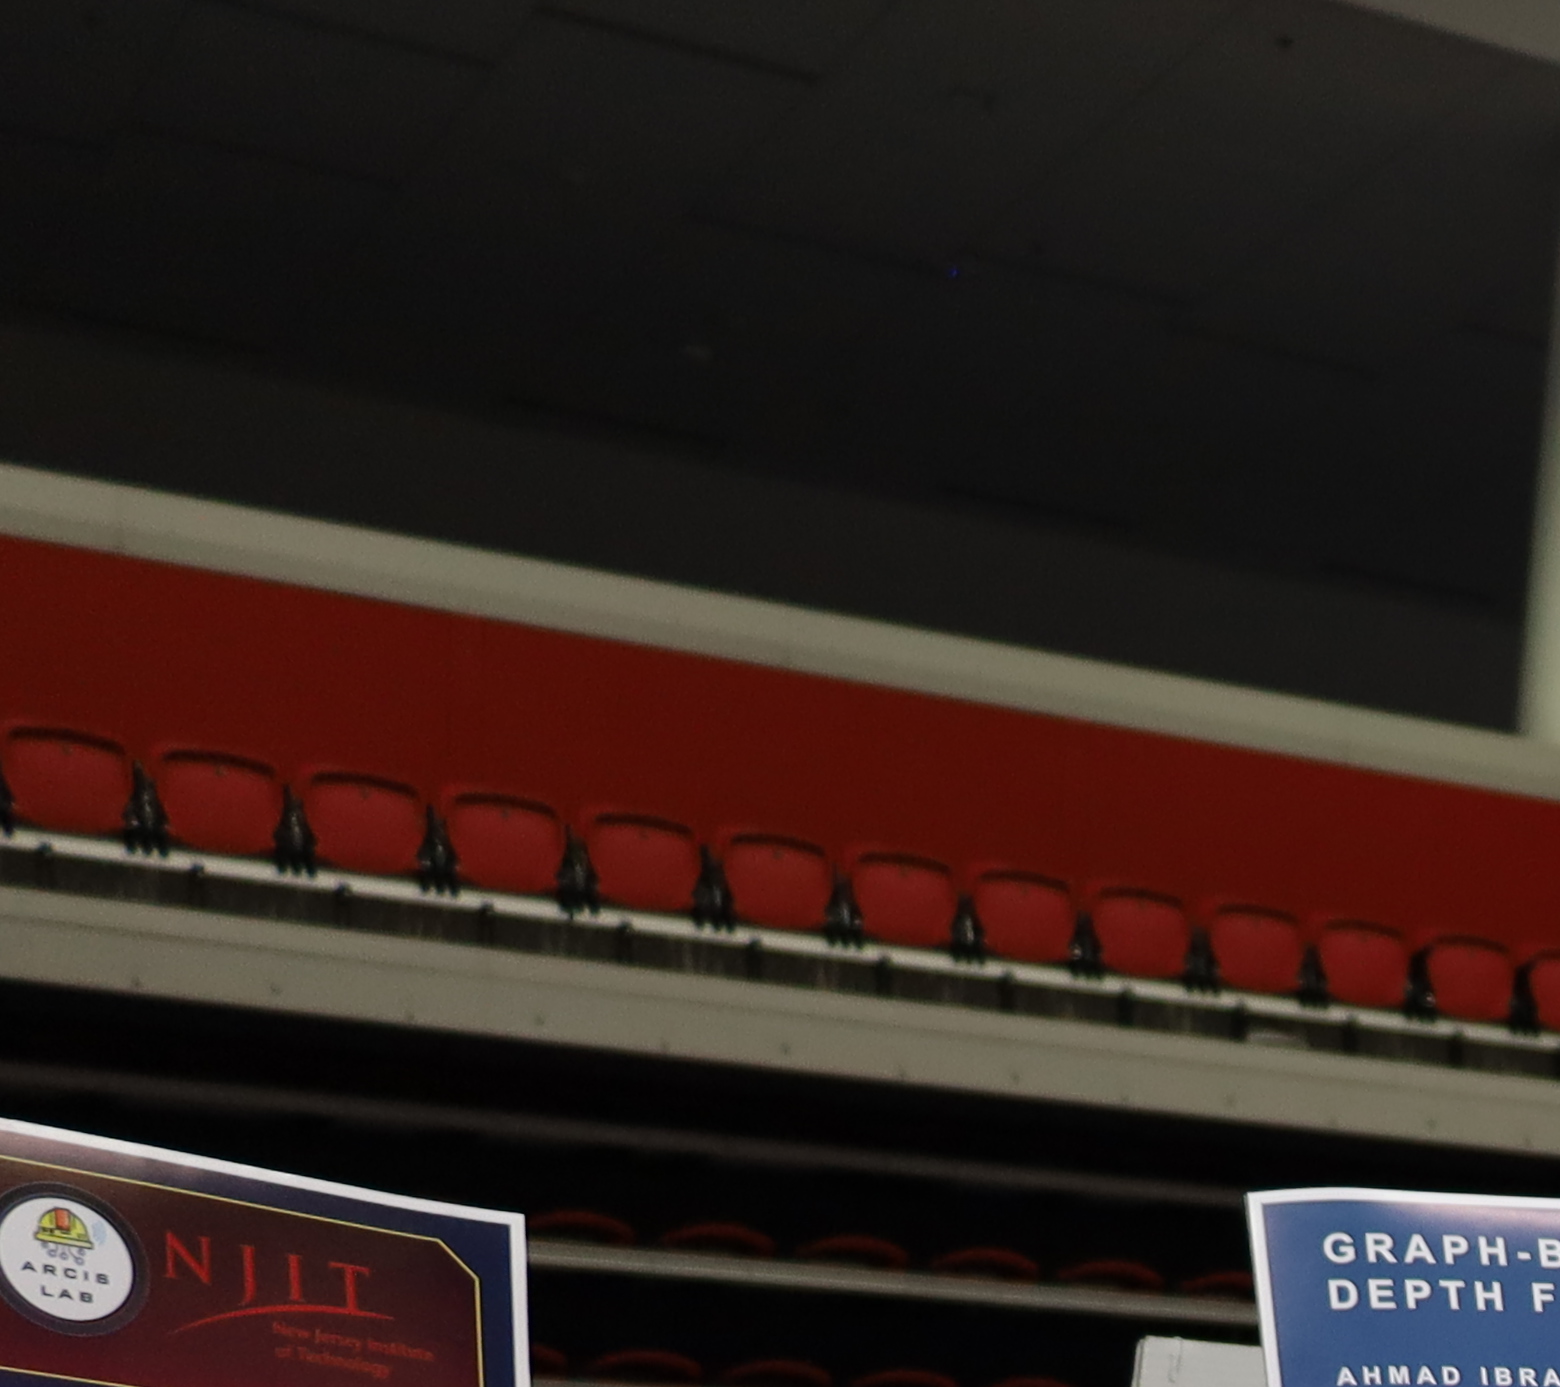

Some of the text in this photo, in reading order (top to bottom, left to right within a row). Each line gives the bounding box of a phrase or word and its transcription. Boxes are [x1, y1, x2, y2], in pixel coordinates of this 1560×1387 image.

[21, 1261, 109, 1285] ARCIS
[163, 1232, 371, 1315] NJIT
[41, 1286, 93, 1303] LAB
[1328, 1279, 1503, 1311] DEPTH
[272, 1321, 310, 1341] New
[314, 1329, 363, 1353] Jersey
[275, 1346, 392, 1381] of Technology
[1337, 1366, 1460, 1386] AHMAD
